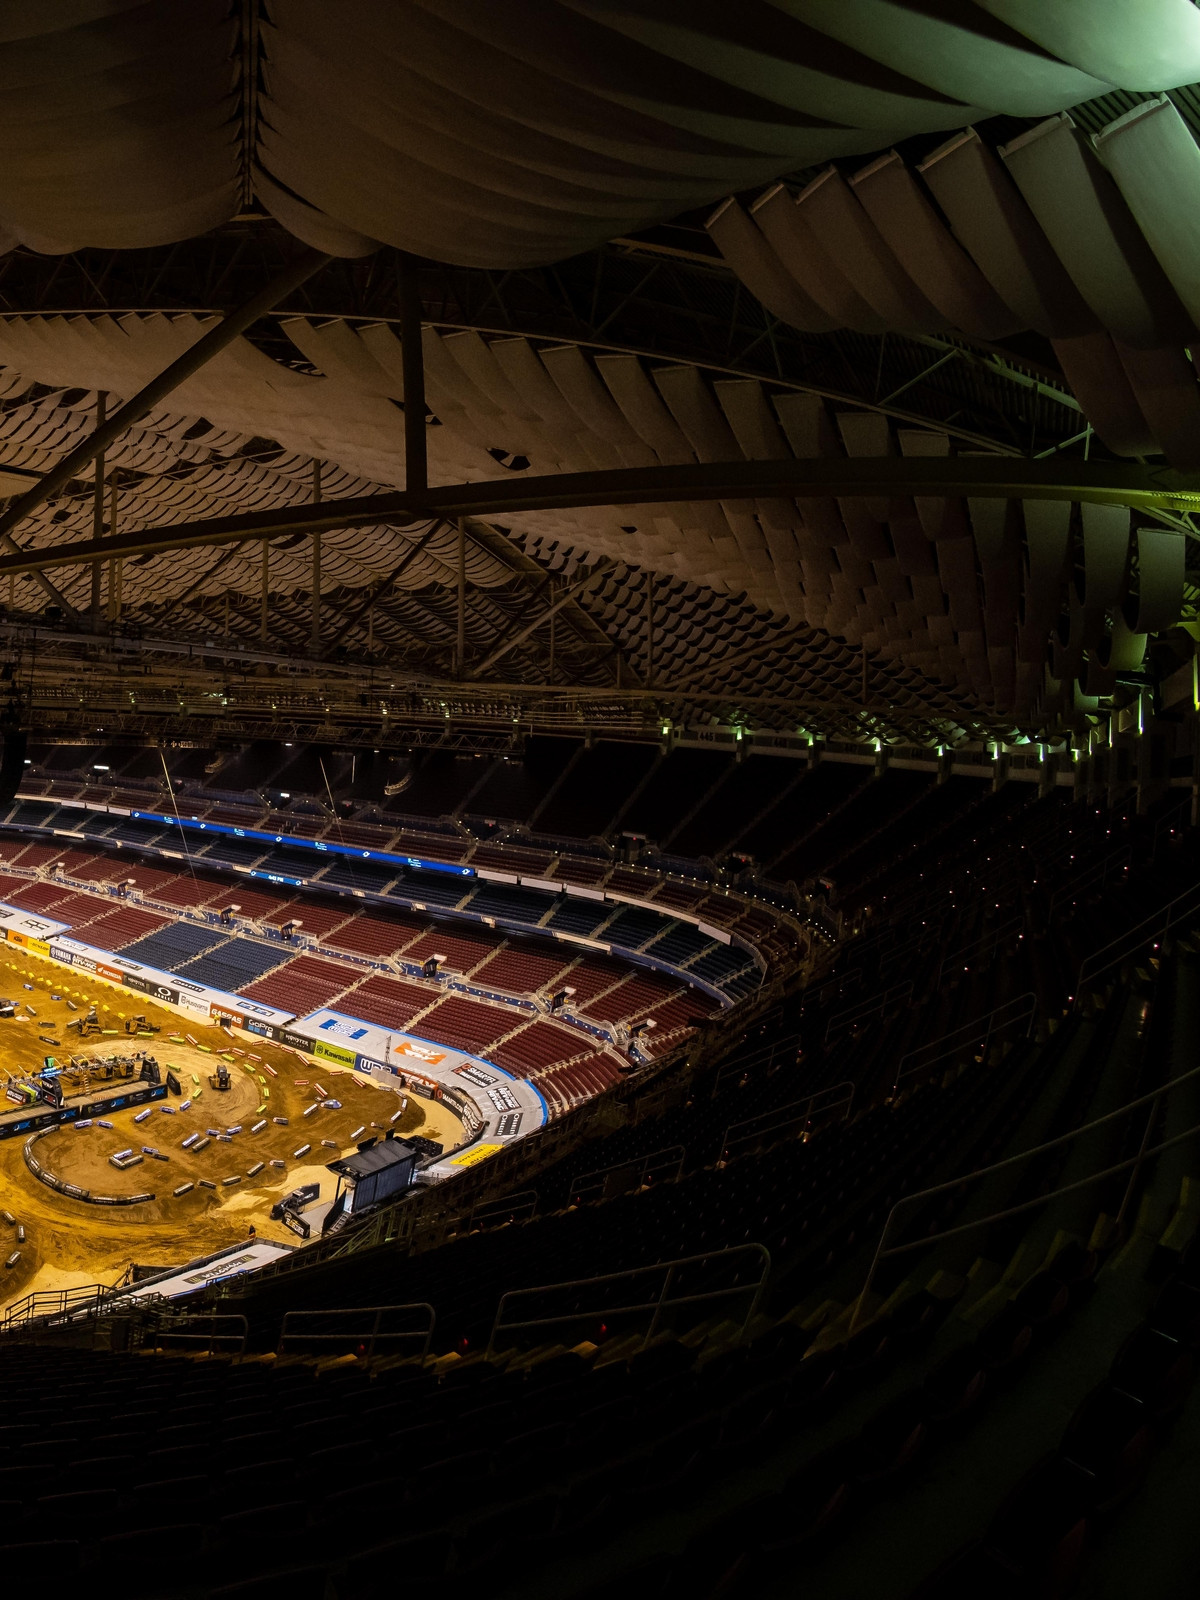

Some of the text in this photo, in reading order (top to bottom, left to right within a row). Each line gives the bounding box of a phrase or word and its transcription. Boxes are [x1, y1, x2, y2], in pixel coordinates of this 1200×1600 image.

[102, 969, 122, 980] HONDA
[153, 992, 174, 1002] OAKLEY
[211, 1008, 242, 1024] GASGAS
[248, 1019, 274, 1033] GoPro
[285, 1033, 309, 1047] MONSTER
[324, 1048, 355, 1064] Kawasaki
